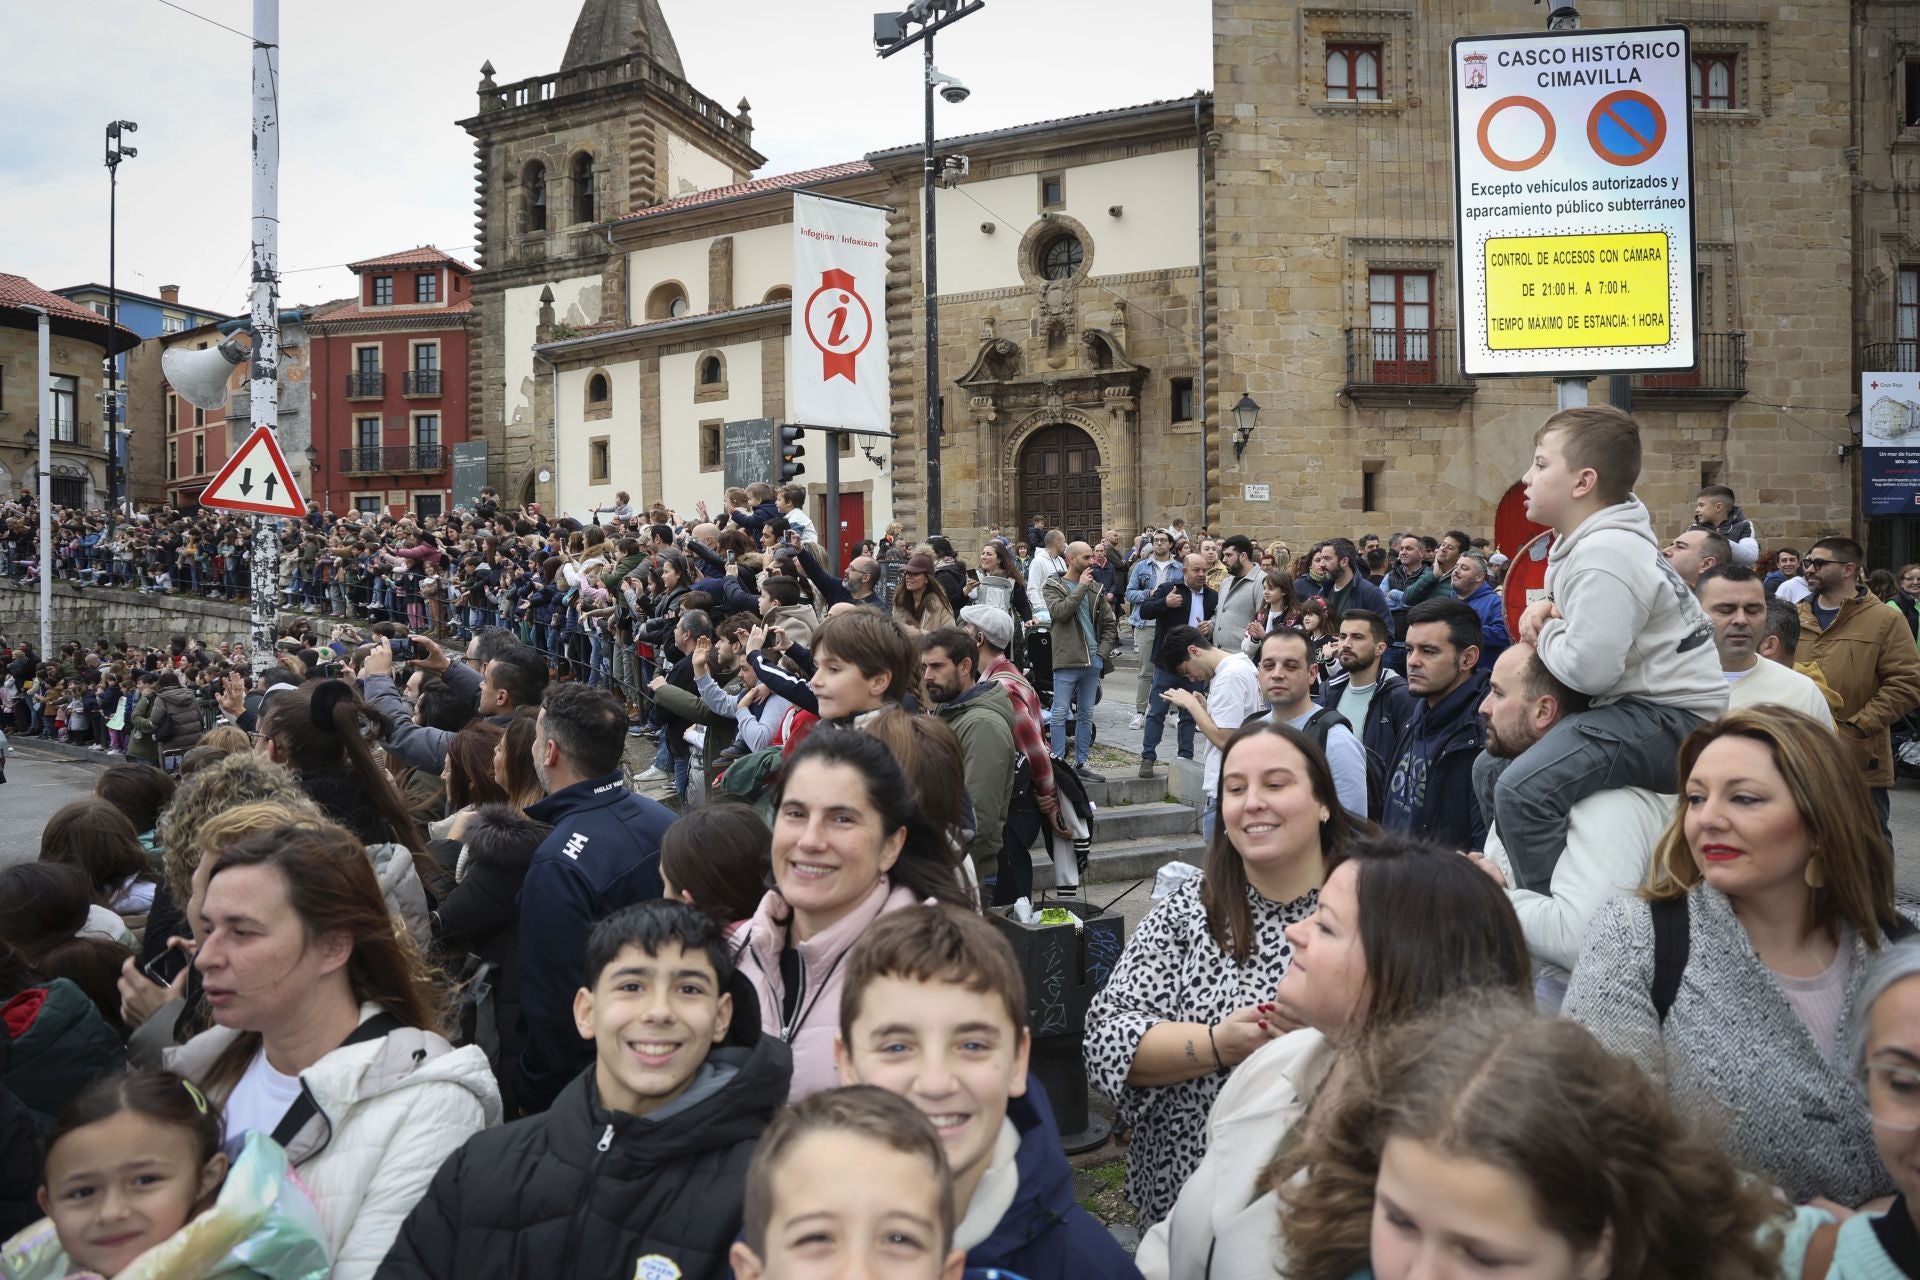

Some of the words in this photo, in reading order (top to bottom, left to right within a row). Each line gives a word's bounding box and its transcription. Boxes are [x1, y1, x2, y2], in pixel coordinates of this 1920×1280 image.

[1497, 49, 1567, 68] CASCO
[1572, 40, 1680, 63] HISTÓRICO
[1537, 67, 1642, 88] CIMAVILLA
[1471, 182, 1523, 198] Excepto
[1526, 178, 1588, 194] vehículos
[1592, 174, 1668, 191] autorizados
[1671, 176, 1679, 191] y
[1465, 202, 1553, 220] aparcamiento
[1556, 199, 1604, 217] público
[1607, 196, 1686, 212] subterráneo
[801, 227, 835, 242] Infogijón
[841, 234, 879, 248] Infoxixón
[1491, 252, 1533, 267] CONTROL
[1537, 251, 1549, 266] DE
[1553, 250, 1595, 265] ACCESOS
[1599, 249, 1619, 264] CON
[1623, 247, 1662, 263] CÁMARA
[1522, 283, 1535, 297] DE
[1542, 282, 1566, 296] 21:00
[1568, 282, 1578, 296] H.
[1584, 281, 1592, 295] A
[1599, 280, 1618, 295] 7:00
[1620, 280, 1630, 294] H.
[1491, 317, 1524, 331] TIEMPO
[1527, 315, 1563, 330] MÁXIMO
[1567, 315, 1580, 329] DE
[1583, 314, 1629, 329] ESTANCIA:
[1631, 313, 1636, 327] 1
[1639, 312, 1665, 327] HORA
[593, 782, 613, 794] HELLY
